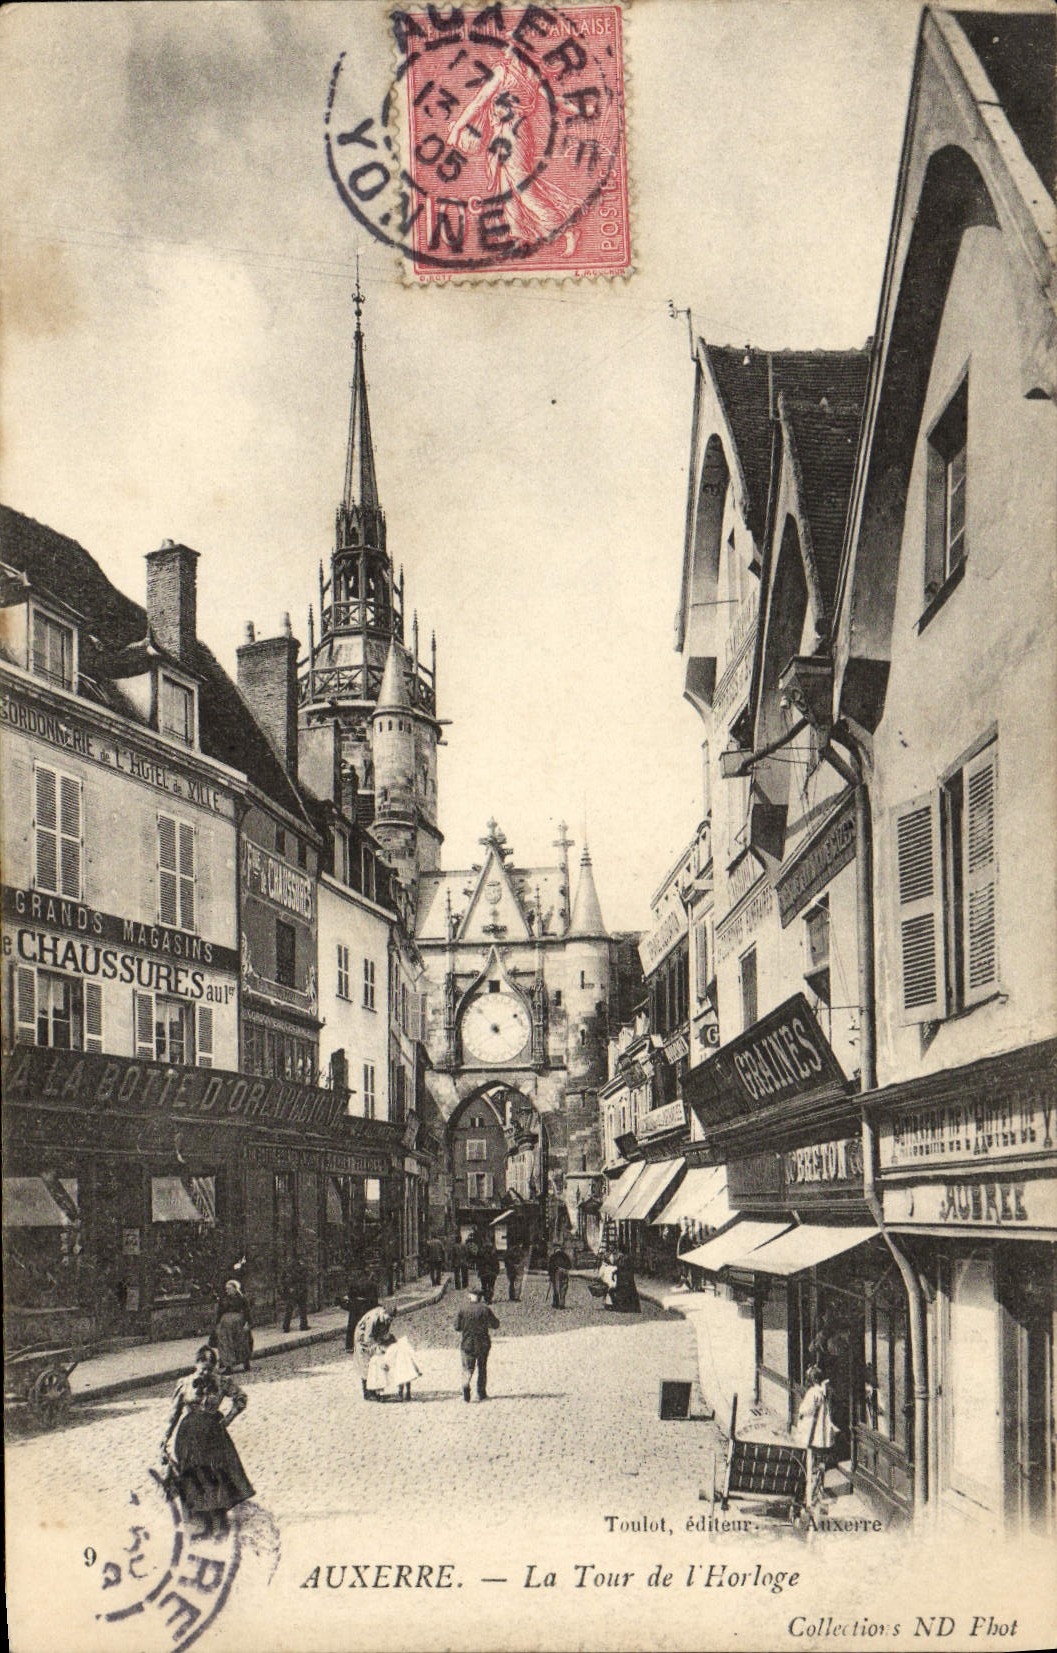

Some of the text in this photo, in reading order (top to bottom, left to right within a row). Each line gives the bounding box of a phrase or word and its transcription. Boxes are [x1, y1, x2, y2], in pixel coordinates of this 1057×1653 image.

[337, 118, 527, 253] YONNE
[415, 134, 468, 183] 05
[15, 890, 214, 964] GRANDS MAGASINS
[17, 928, 205, 1000] CHAUSSURES
[206, 986, 220, 1002] au
[733, 1017, 822, 1100] GRAINES
